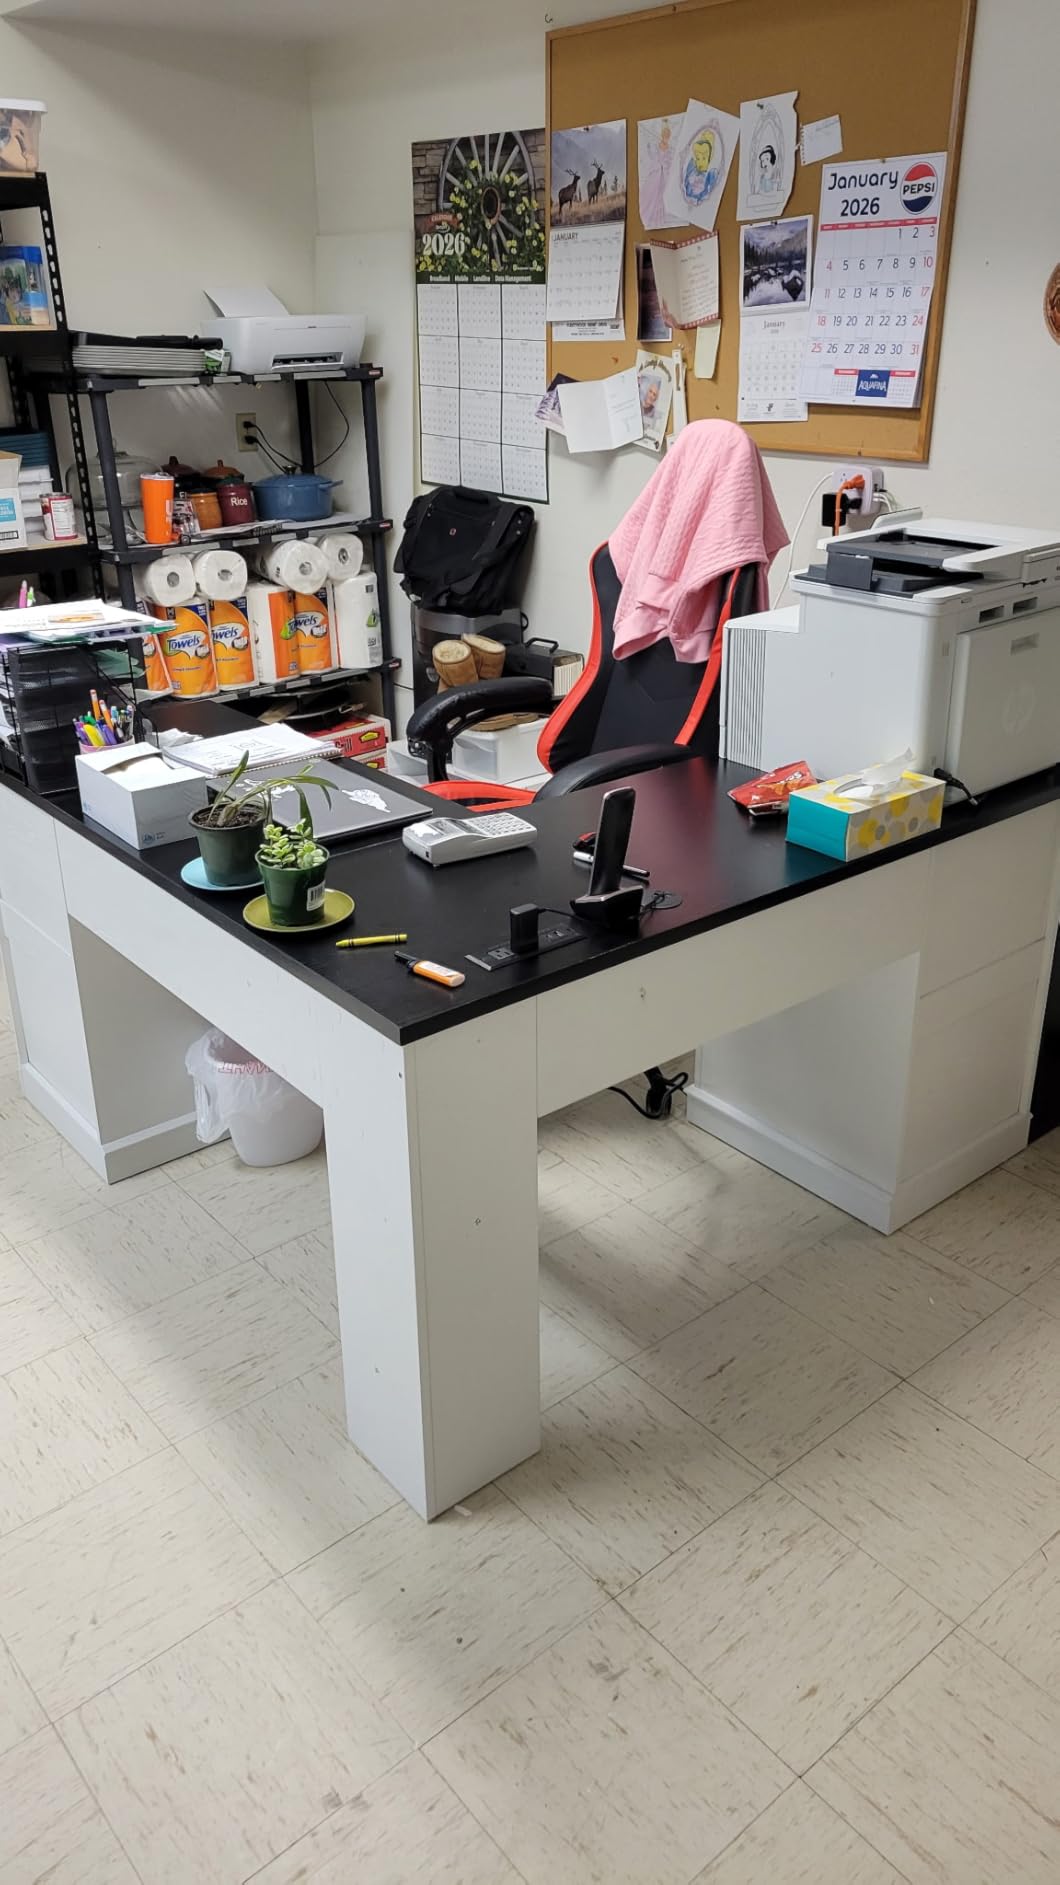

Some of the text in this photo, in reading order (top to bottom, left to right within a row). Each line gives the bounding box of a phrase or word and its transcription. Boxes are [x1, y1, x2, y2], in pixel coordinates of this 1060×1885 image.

[828, 170, 899, 190] January
[902, 182, 935, 195] PEPSI
[840, 197, 880, 217] 2026
[553, 232, 578, 241] JANUARY
[912, 227, 919, 238] 2
[929, 226, 936, 238] 3
[422, 232, 465, 255] 2026
[826, 256, 934, 271] 4 5 6 7 8 9 10
[824, 286, 930, 299] 11 12 13 14 15 16 17
[762, 320, 785, 330] January
[817, 315, 924, 326] 18 19 20 21 22 23 24
[811, 342, 920, 355] 25 26 27 28 29 30 31
[858, 380, 887, 391] AQUAFINA
[230, 496, 248, 506] Rice
[167, 635, 201, 650] Towels
